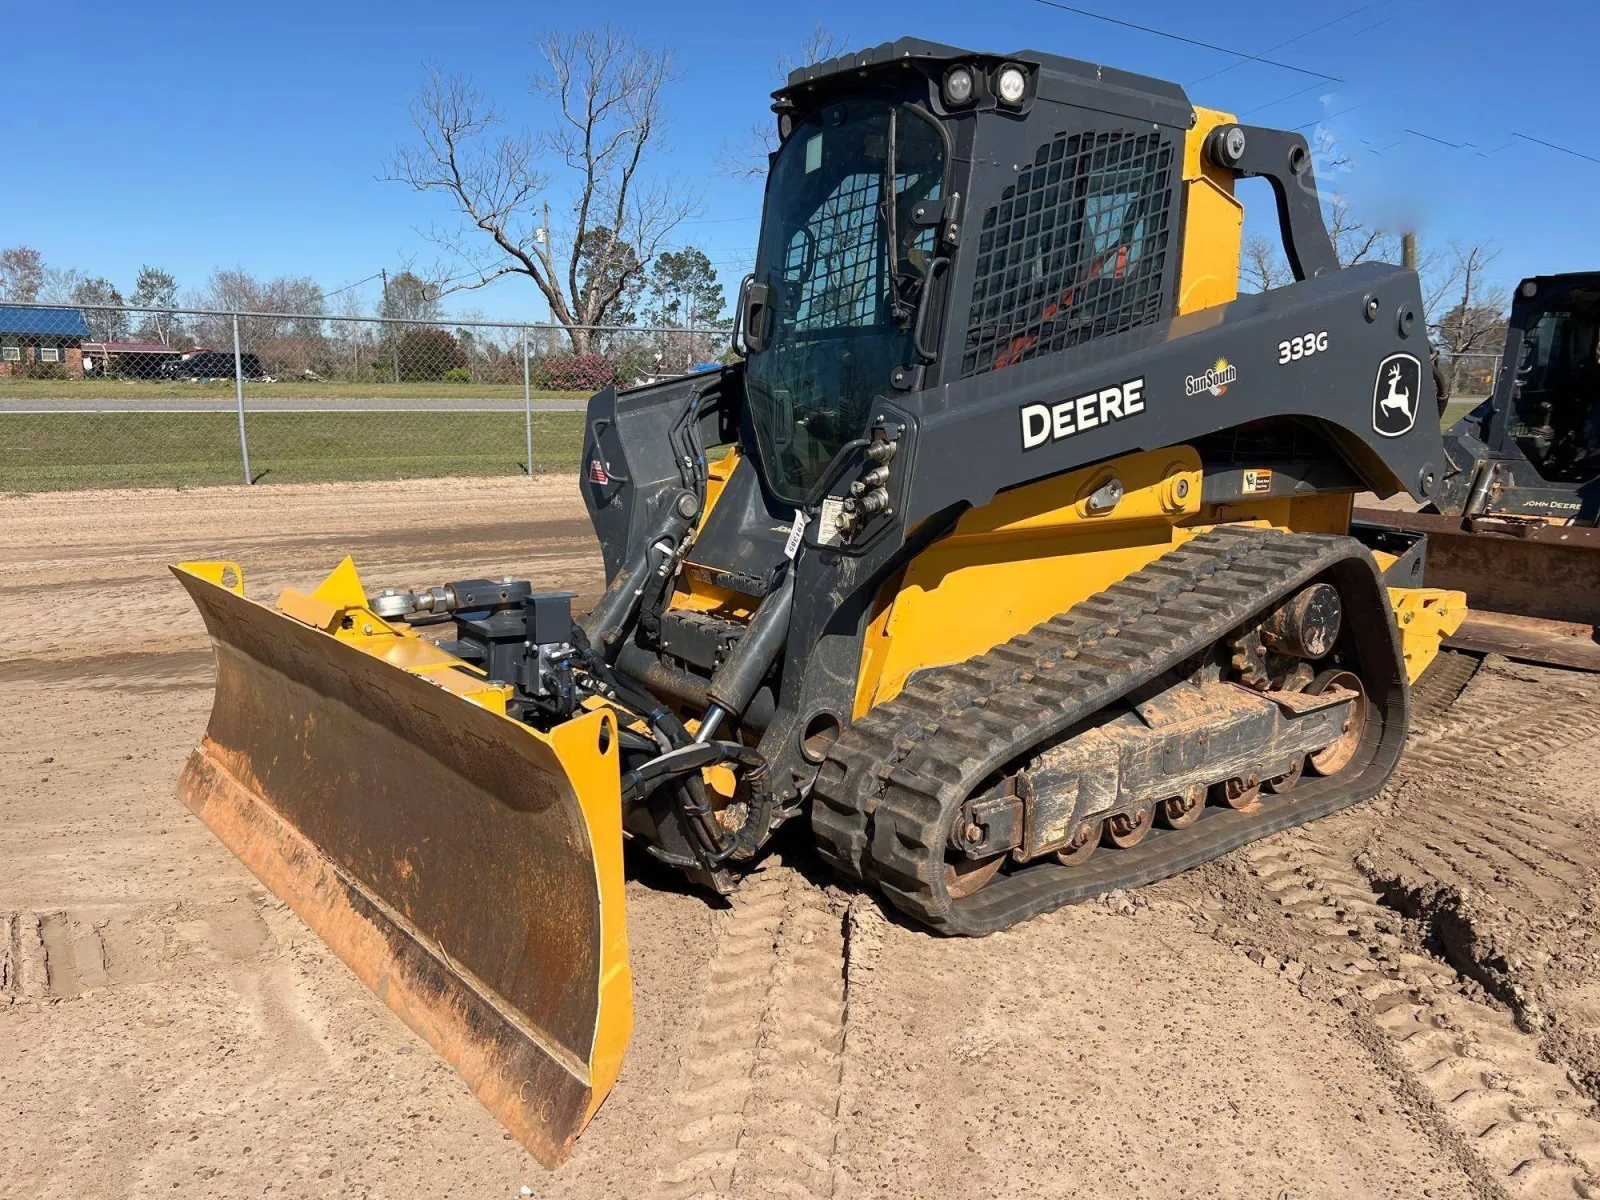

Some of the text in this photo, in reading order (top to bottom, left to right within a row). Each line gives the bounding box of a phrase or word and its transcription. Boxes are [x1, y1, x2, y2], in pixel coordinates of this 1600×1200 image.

[1278, 331, 1328, 364] 333G
[1185, 365, 1237, 396] SunSouth
[1021, 378, 1145, 449] DEERE
[1550, 501, 1582, 510] DEERE
[789, 522, 804, 553] 191385
